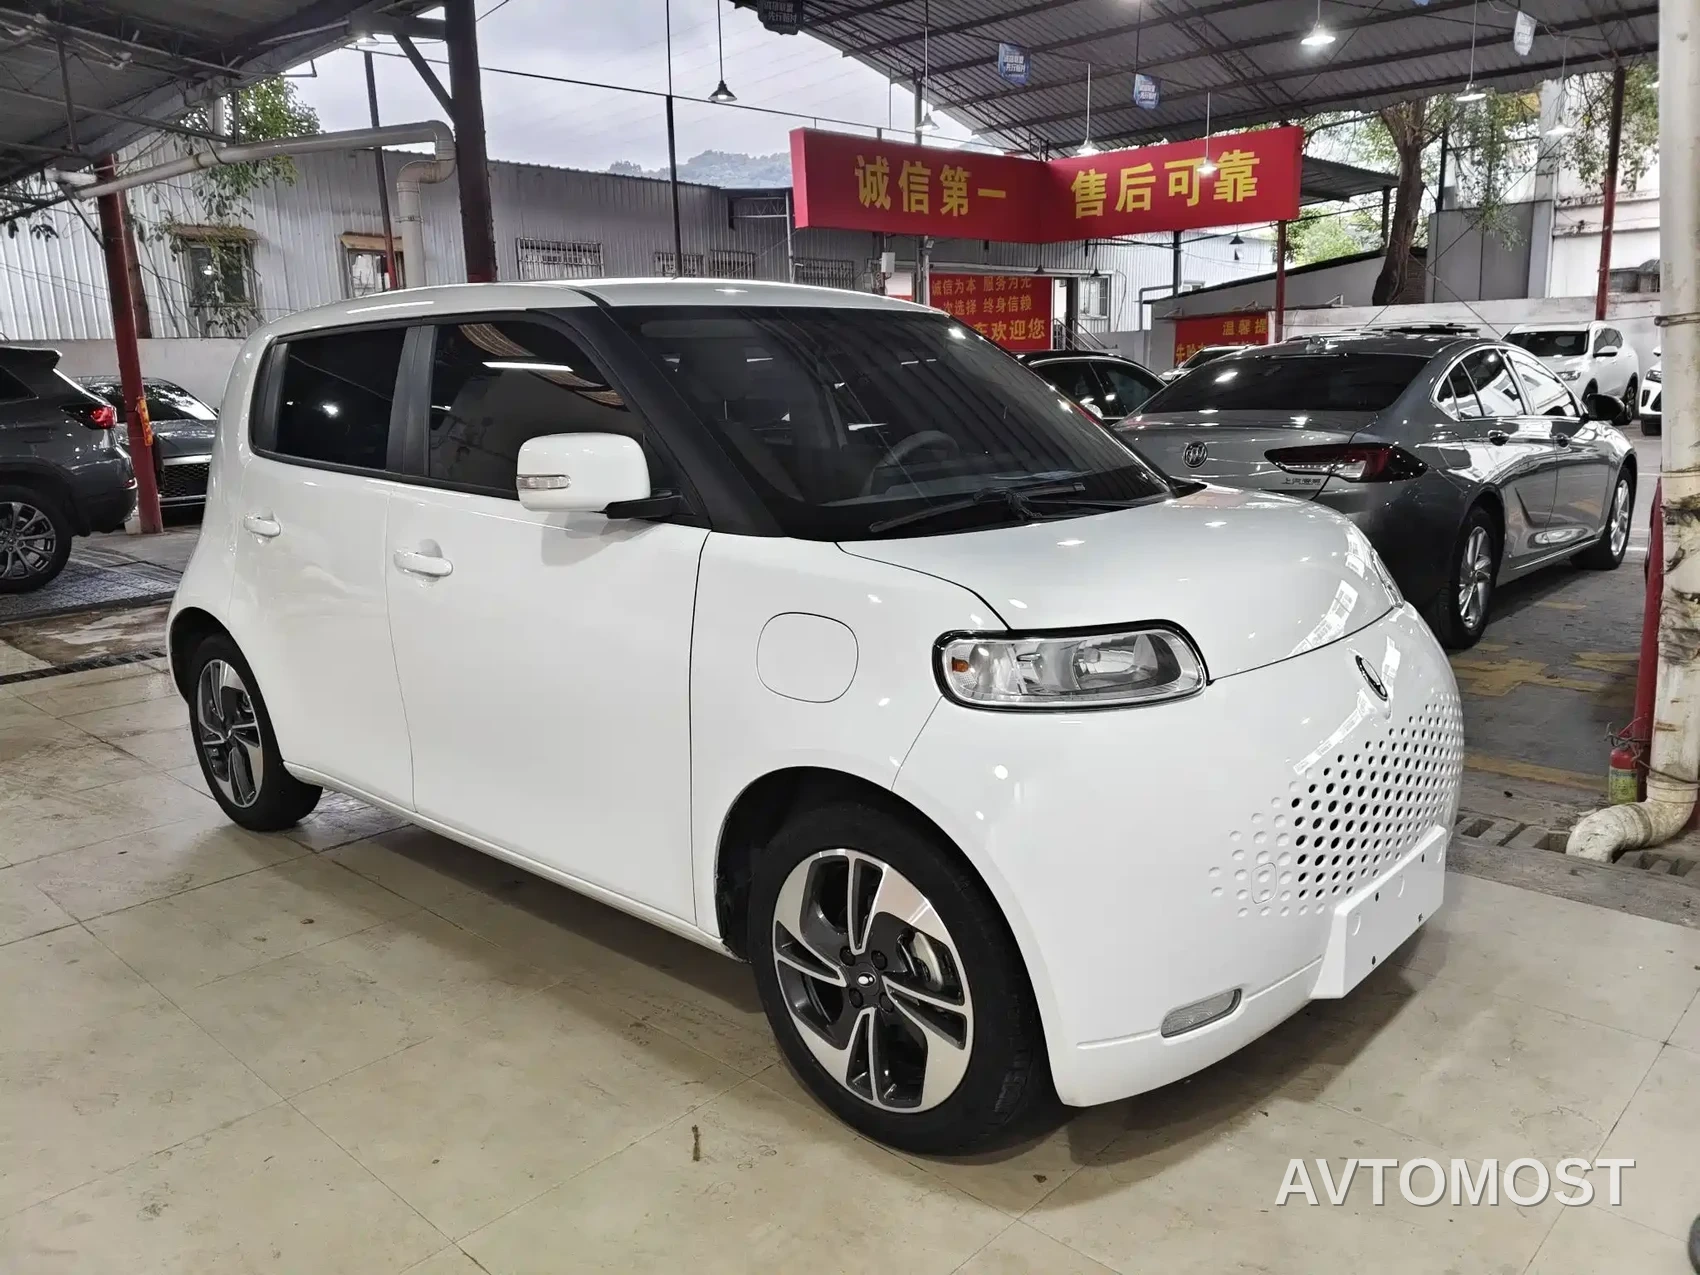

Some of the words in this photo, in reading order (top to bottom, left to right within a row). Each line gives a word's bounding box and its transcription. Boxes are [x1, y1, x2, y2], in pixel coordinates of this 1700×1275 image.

[855, 154, 1006, 217] 诚信第一
[1071, 148, 1261, 219] 售后可靠
[932, 277, 976, 296] 诚信为本
[983, 294, 1032, 314] 终身信赖
